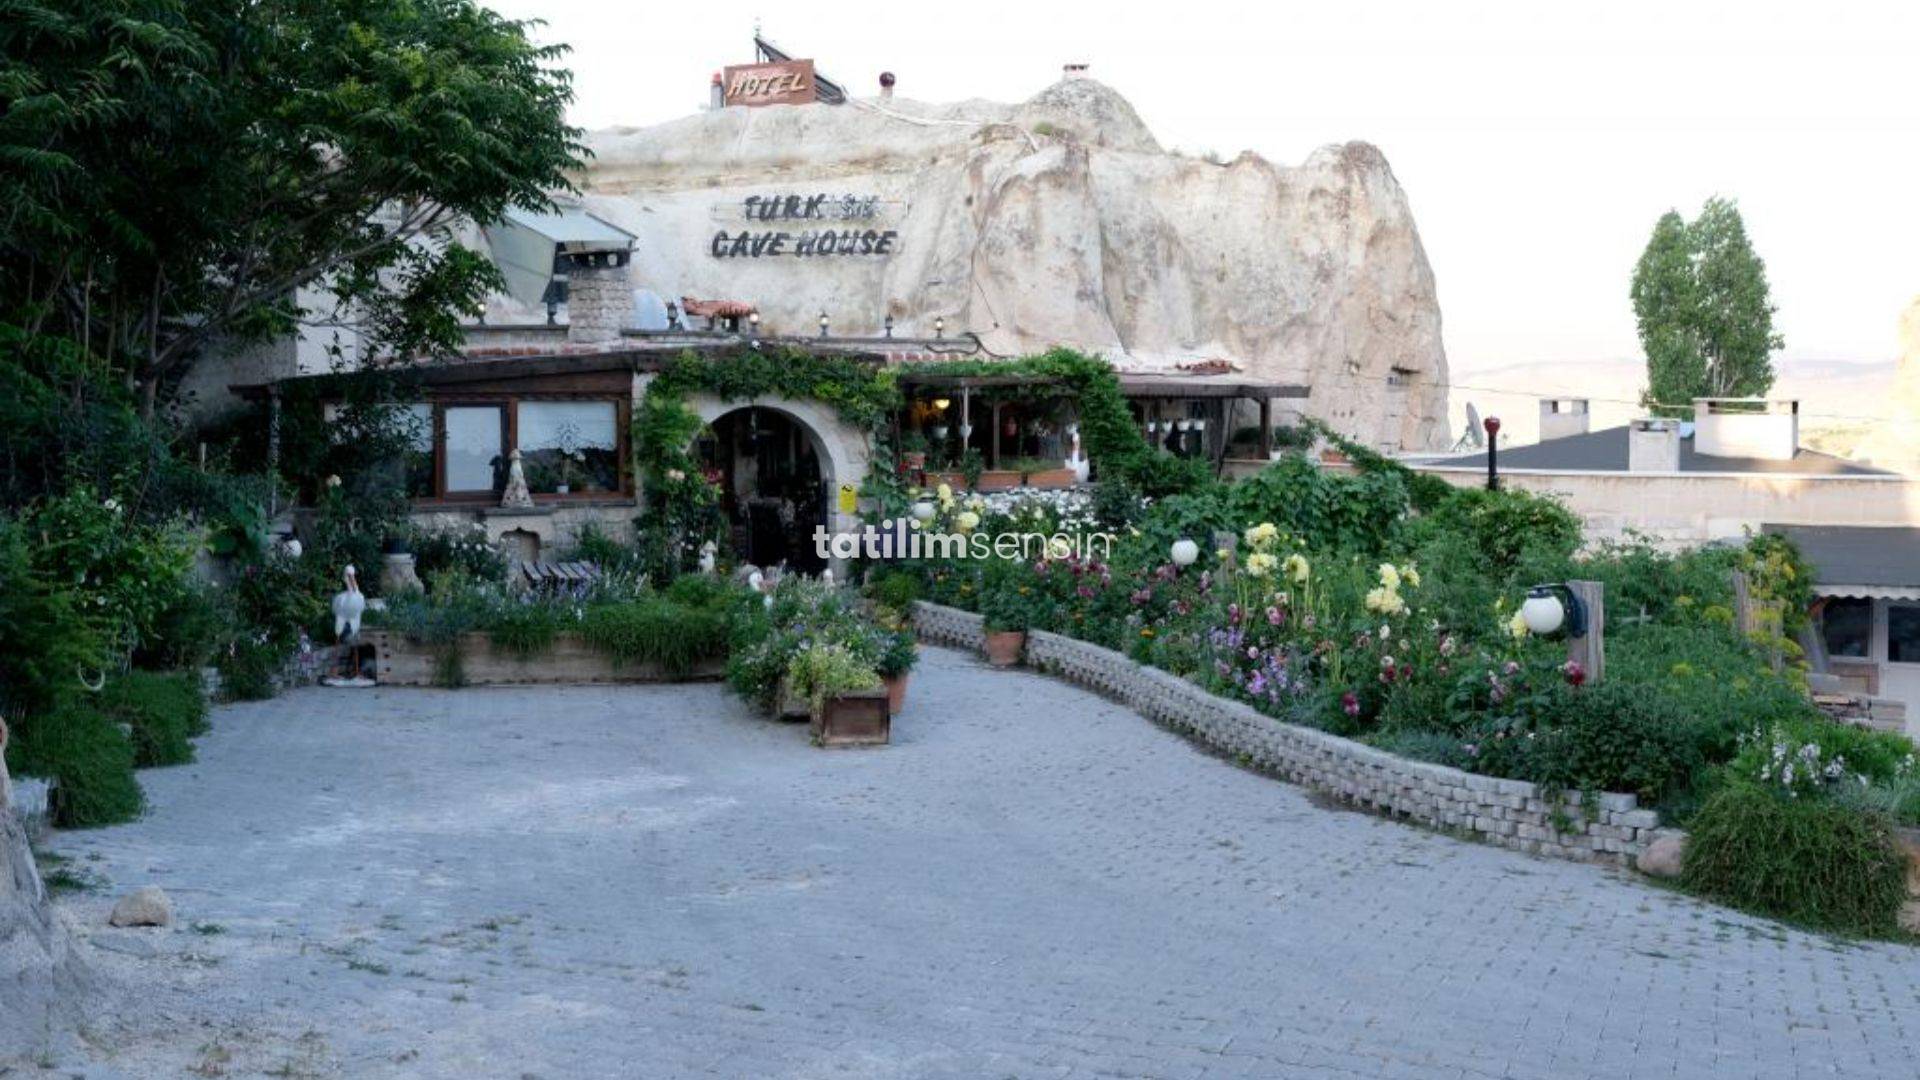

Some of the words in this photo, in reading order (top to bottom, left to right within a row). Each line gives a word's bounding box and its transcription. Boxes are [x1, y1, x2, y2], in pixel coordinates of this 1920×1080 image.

[727, 73, 807, 98] HOTEL
[712, 231, 790, 258] CAVE
[796, 230, 897, 258] HOUSE
